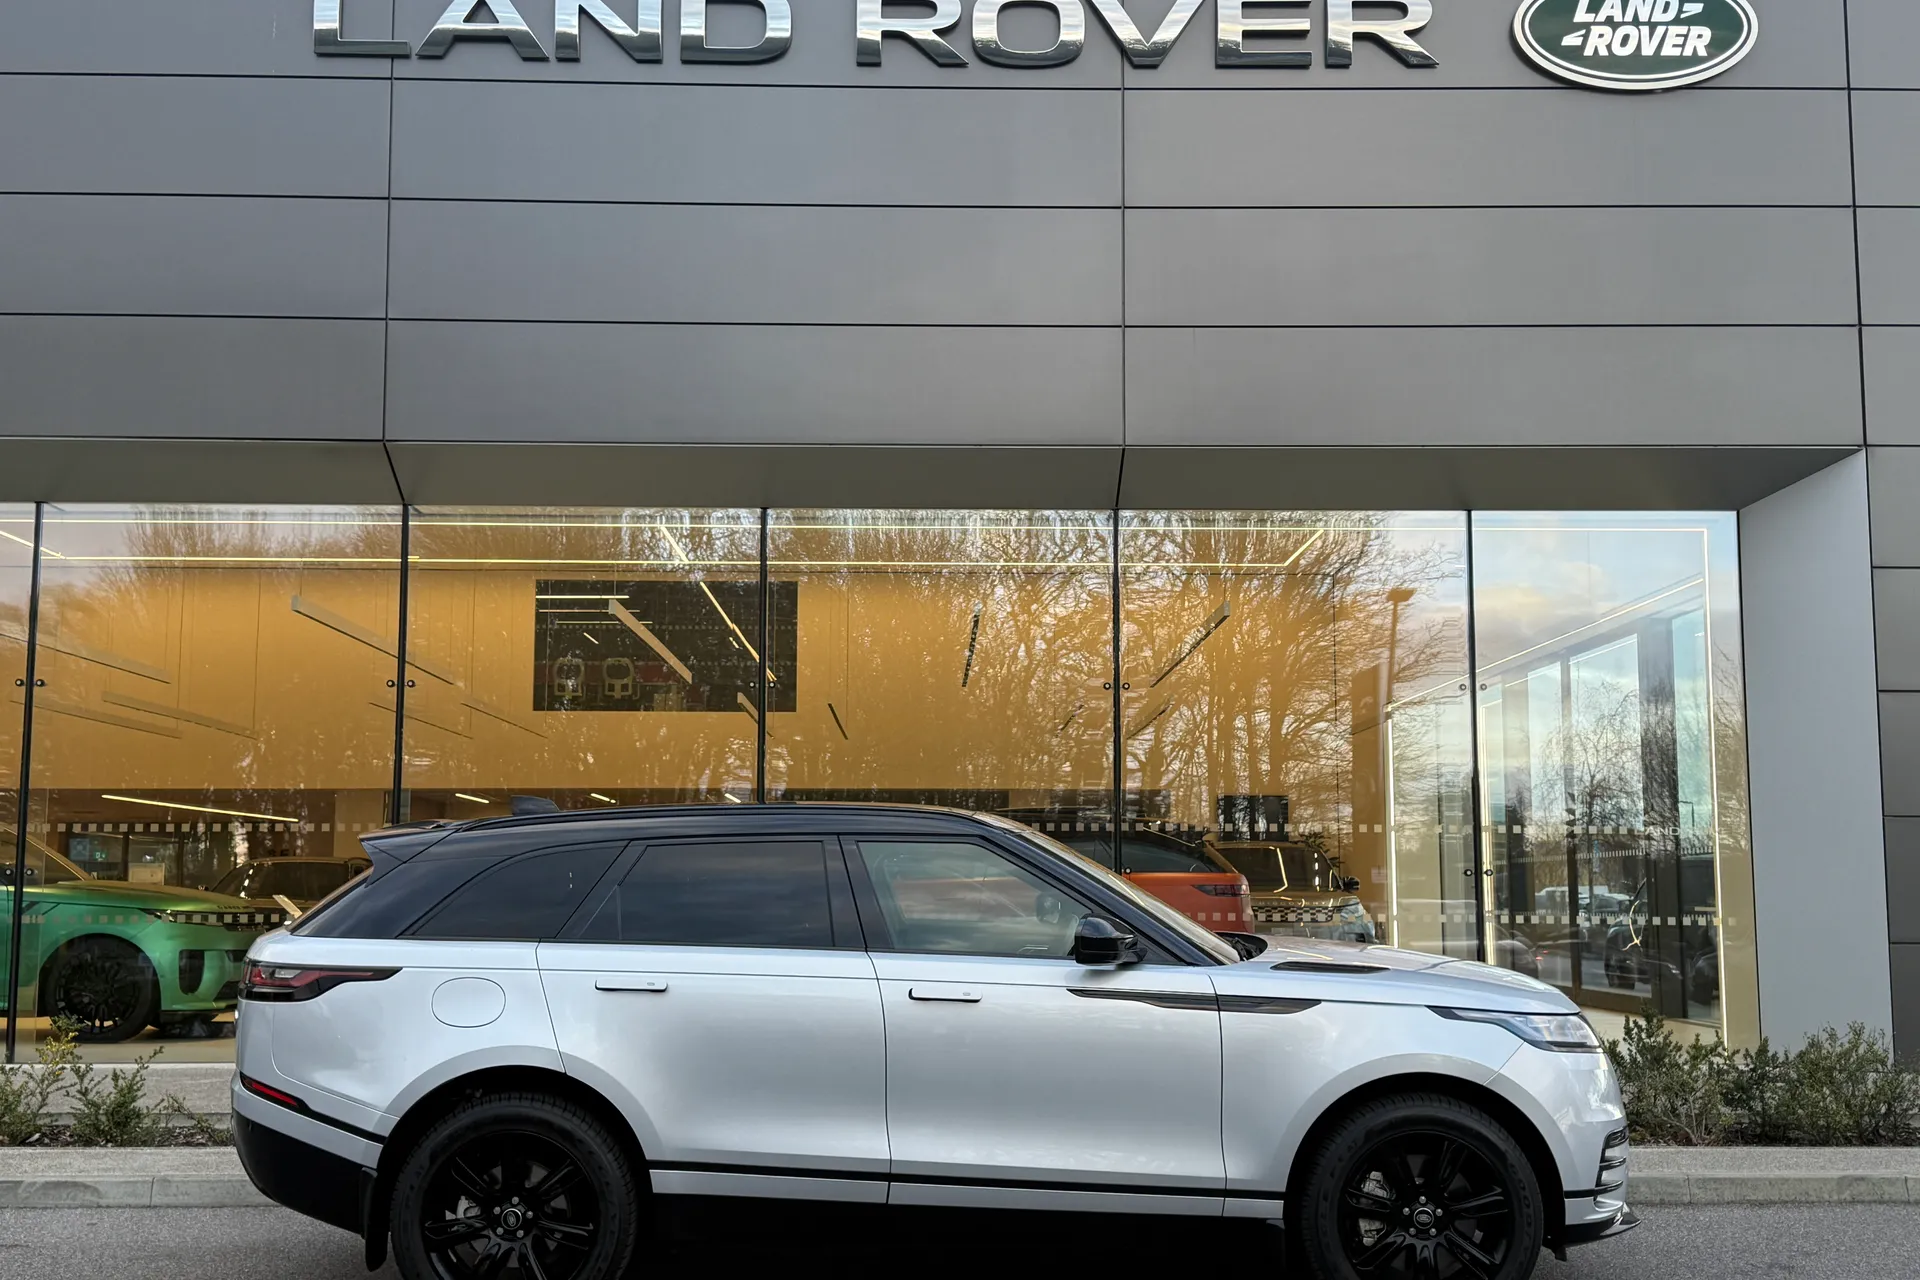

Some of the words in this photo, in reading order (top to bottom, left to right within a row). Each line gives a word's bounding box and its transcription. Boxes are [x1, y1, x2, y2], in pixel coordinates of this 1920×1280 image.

[1573, 0, 1679, 23] LAND
[313, 0, 792, 64] LAND
[855, 0, 1440, 68] ROVER
[1583, 25, 1712, 57] ROVER
